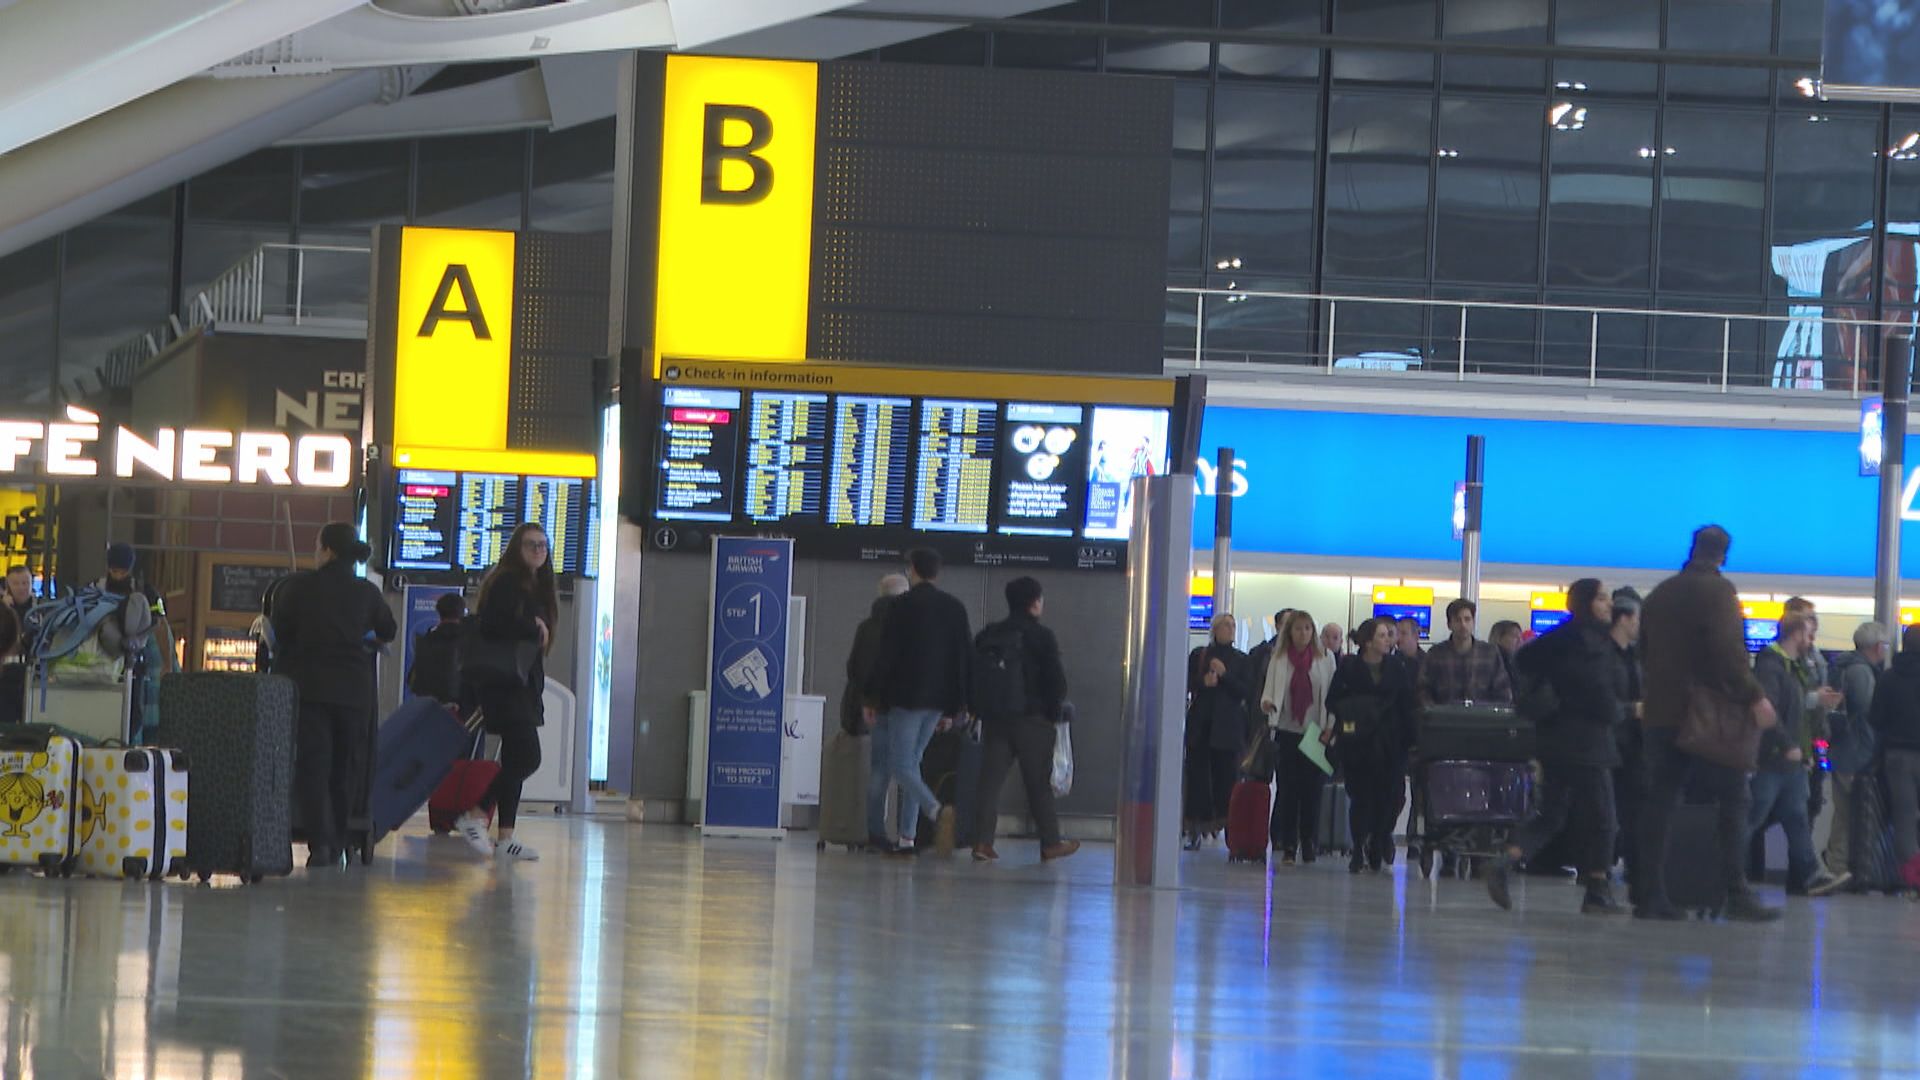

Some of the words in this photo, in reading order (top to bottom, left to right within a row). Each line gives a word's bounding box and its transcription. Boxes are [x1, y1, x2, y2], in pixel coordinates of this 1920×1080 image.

[701, 103, 775, 206] B
[416, 264, 492, 341] A
[685, 367, 745, 380] Check-in
[750, 368, 833, 385] information
[116, 423, 352, 487] NERO
[726, 563, 764, 574] AIRWAYS
[728, 555, 763, 565] BRITISH
[726, 608, 747, 618] STEP
[749, 592, 761, 636] 1
[717, 766, 737, 775] THEN
[739, 767, 772, 776] PROCEED
[727, 775, 737, 784] TO
[738, 776, 756, 784] STEP
